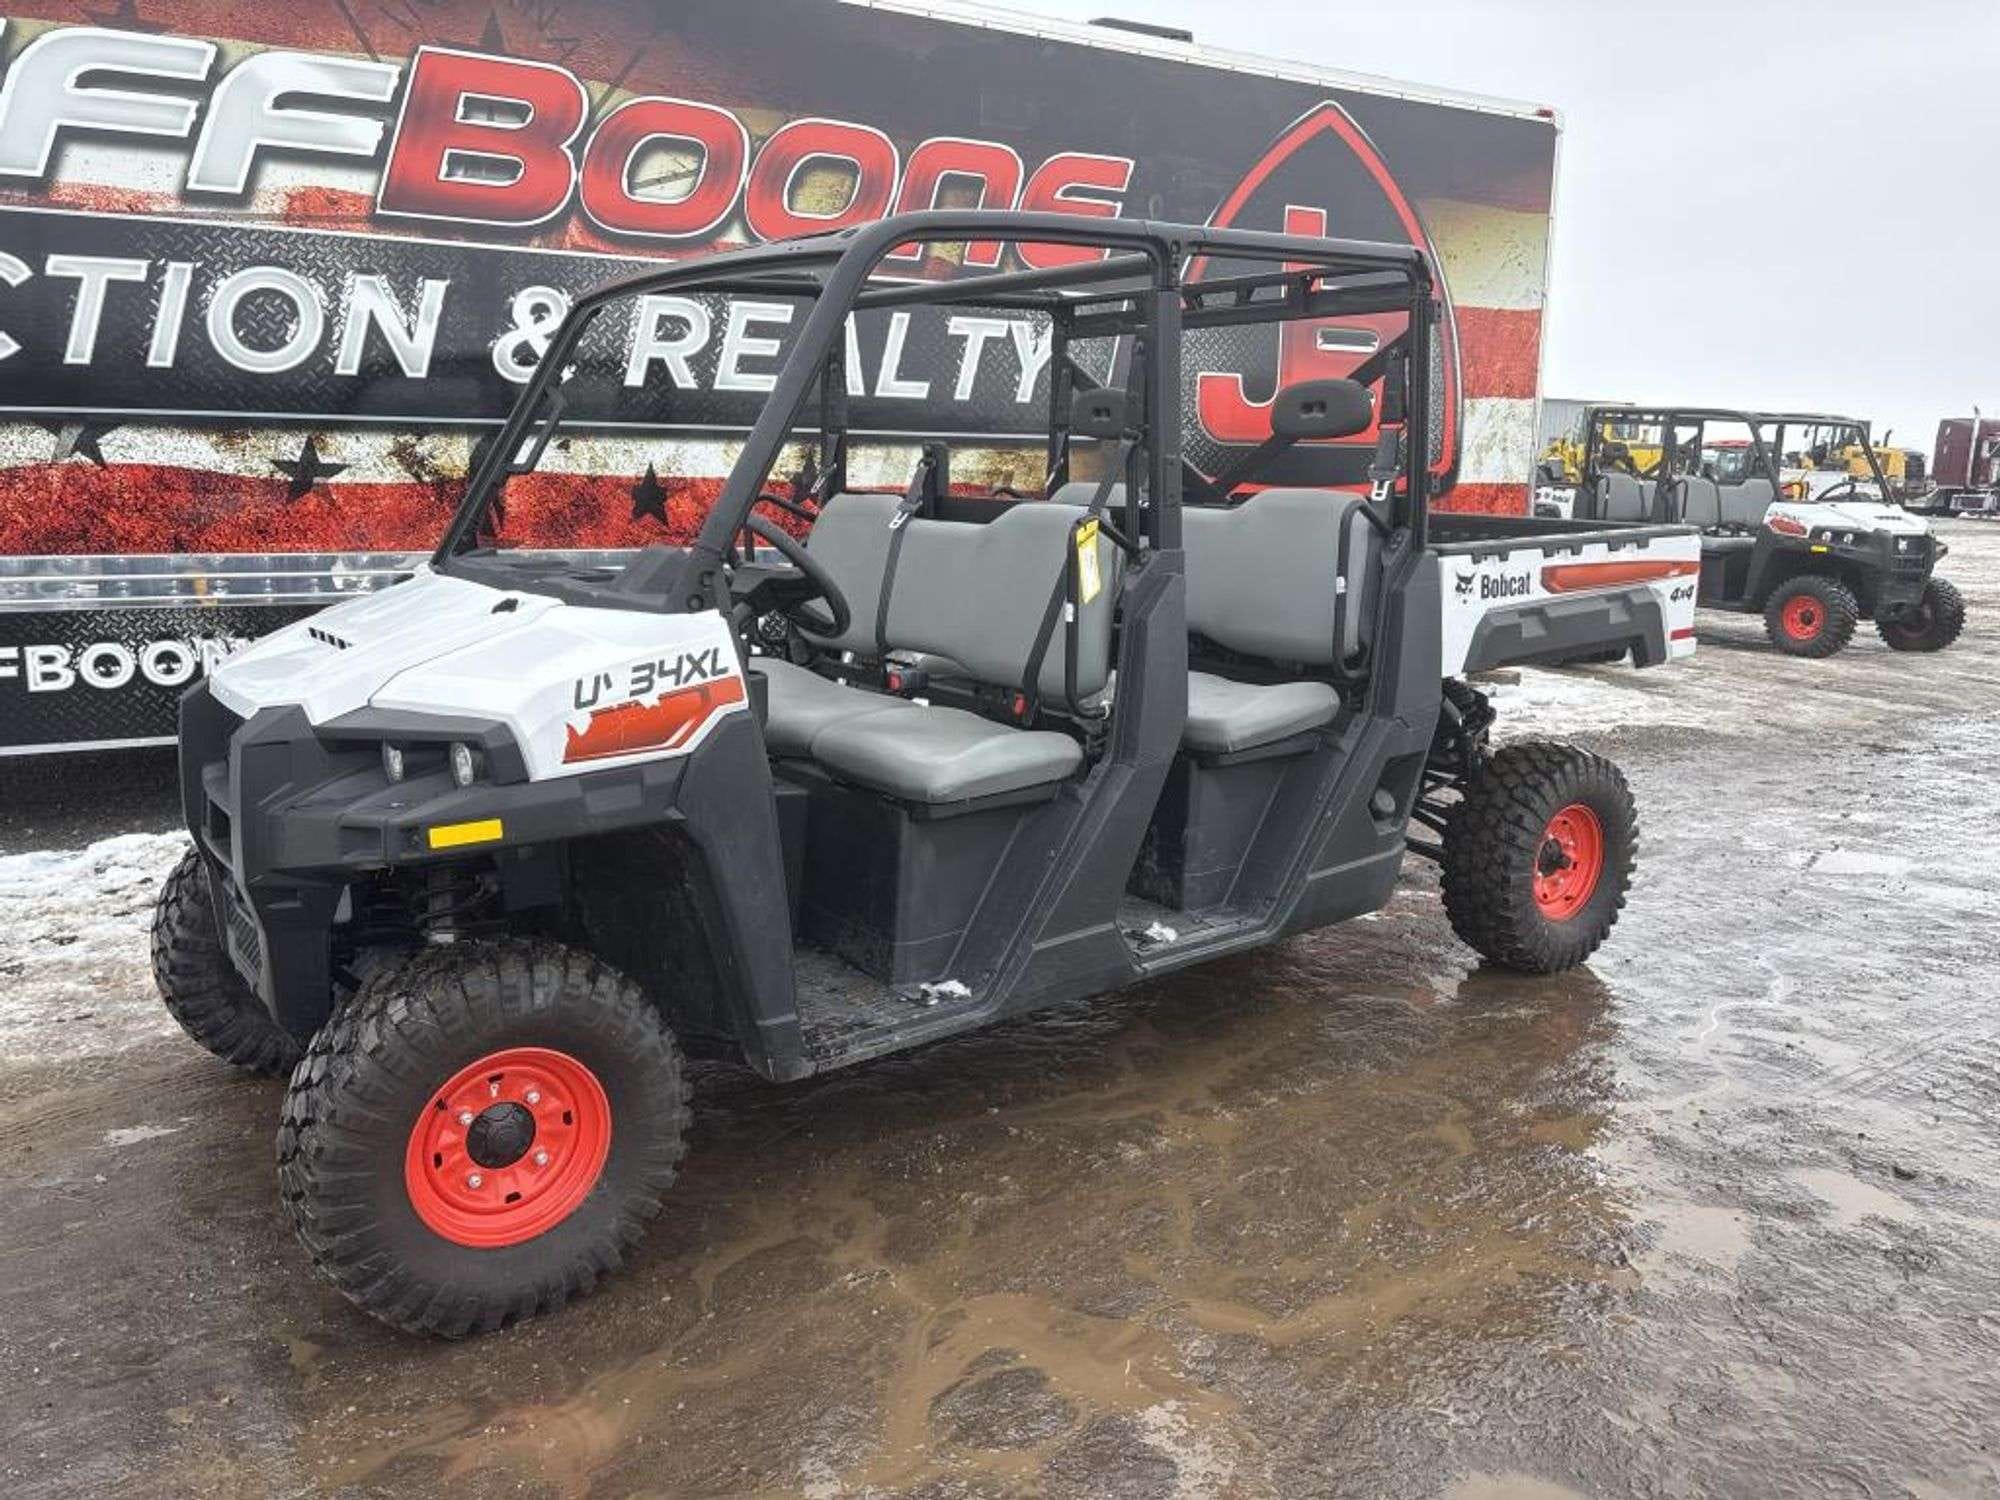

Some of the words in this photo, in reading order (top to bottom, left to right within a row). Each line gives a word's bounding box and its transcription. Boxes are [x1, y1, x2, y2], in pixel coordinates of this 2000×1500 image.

[492, 285, 568, 384] &
[1480, 572, 1531, 599] Bobcat
[1670, 585, 1695, 602] 4x4
